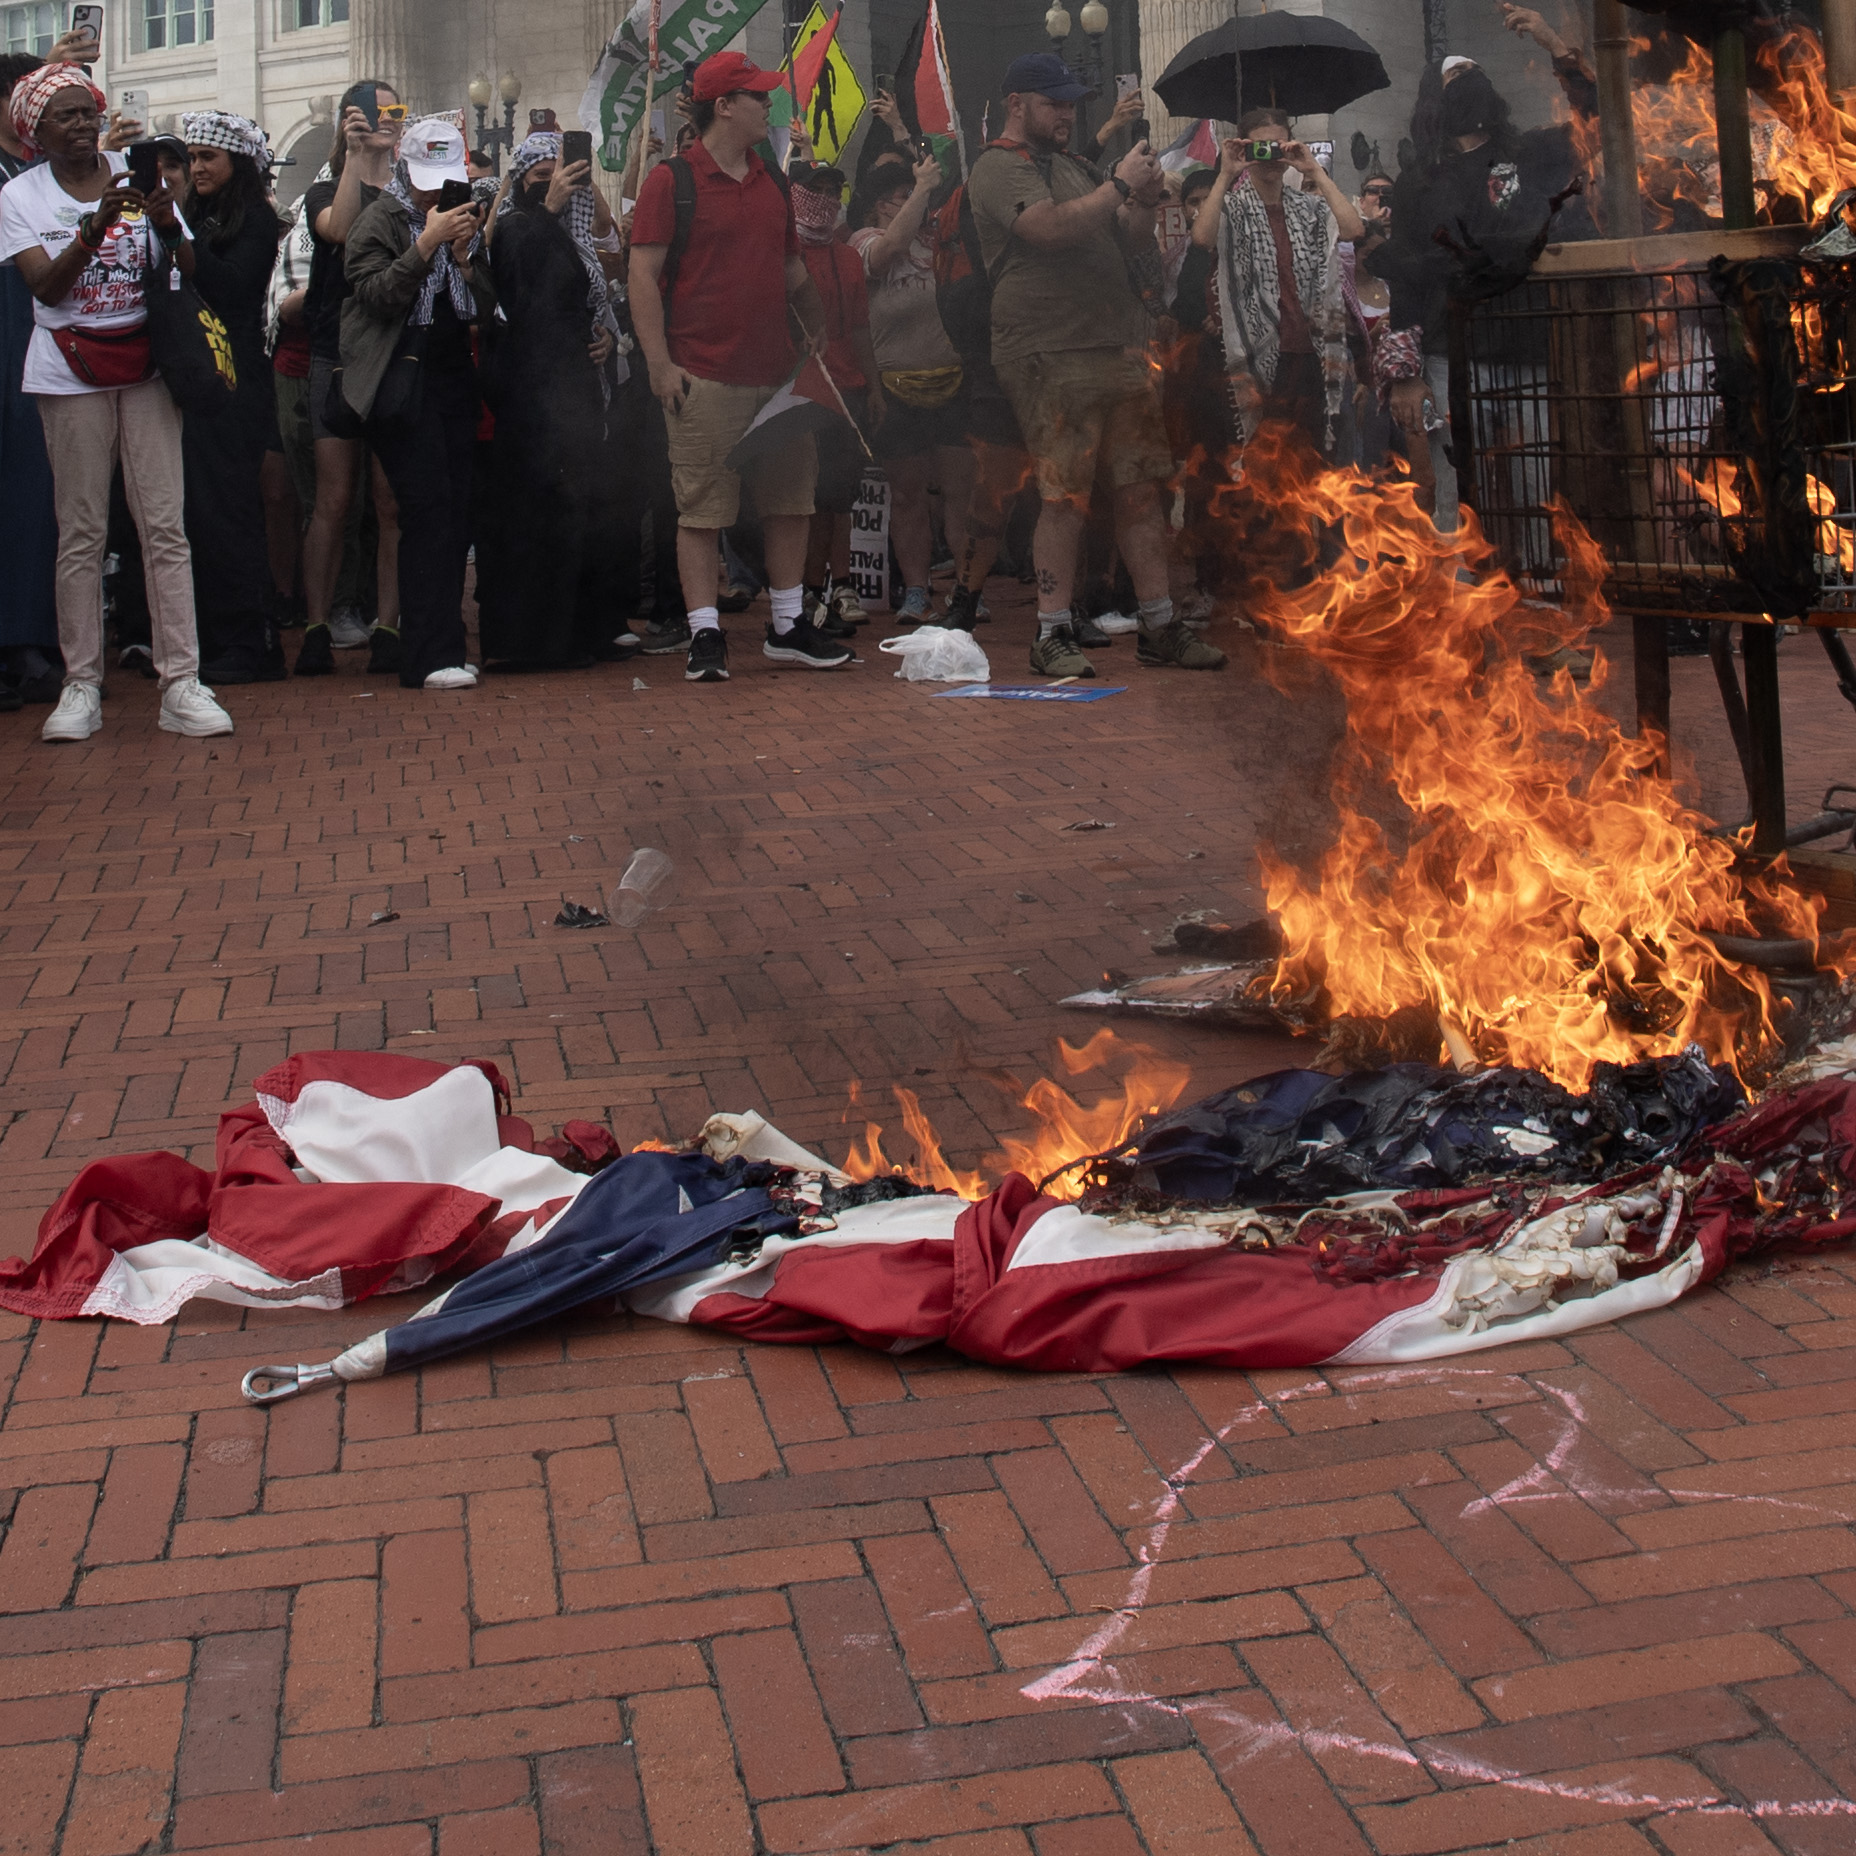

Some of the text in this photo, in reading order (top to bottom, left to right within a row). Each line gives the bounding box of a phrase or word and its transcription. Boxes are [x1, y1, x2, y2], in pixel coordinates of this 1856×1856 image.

[82, 267, 143, 285] THE WHOLE
[80, 300, 110, 315] GOT
[112, 299, 126, 312] TO
